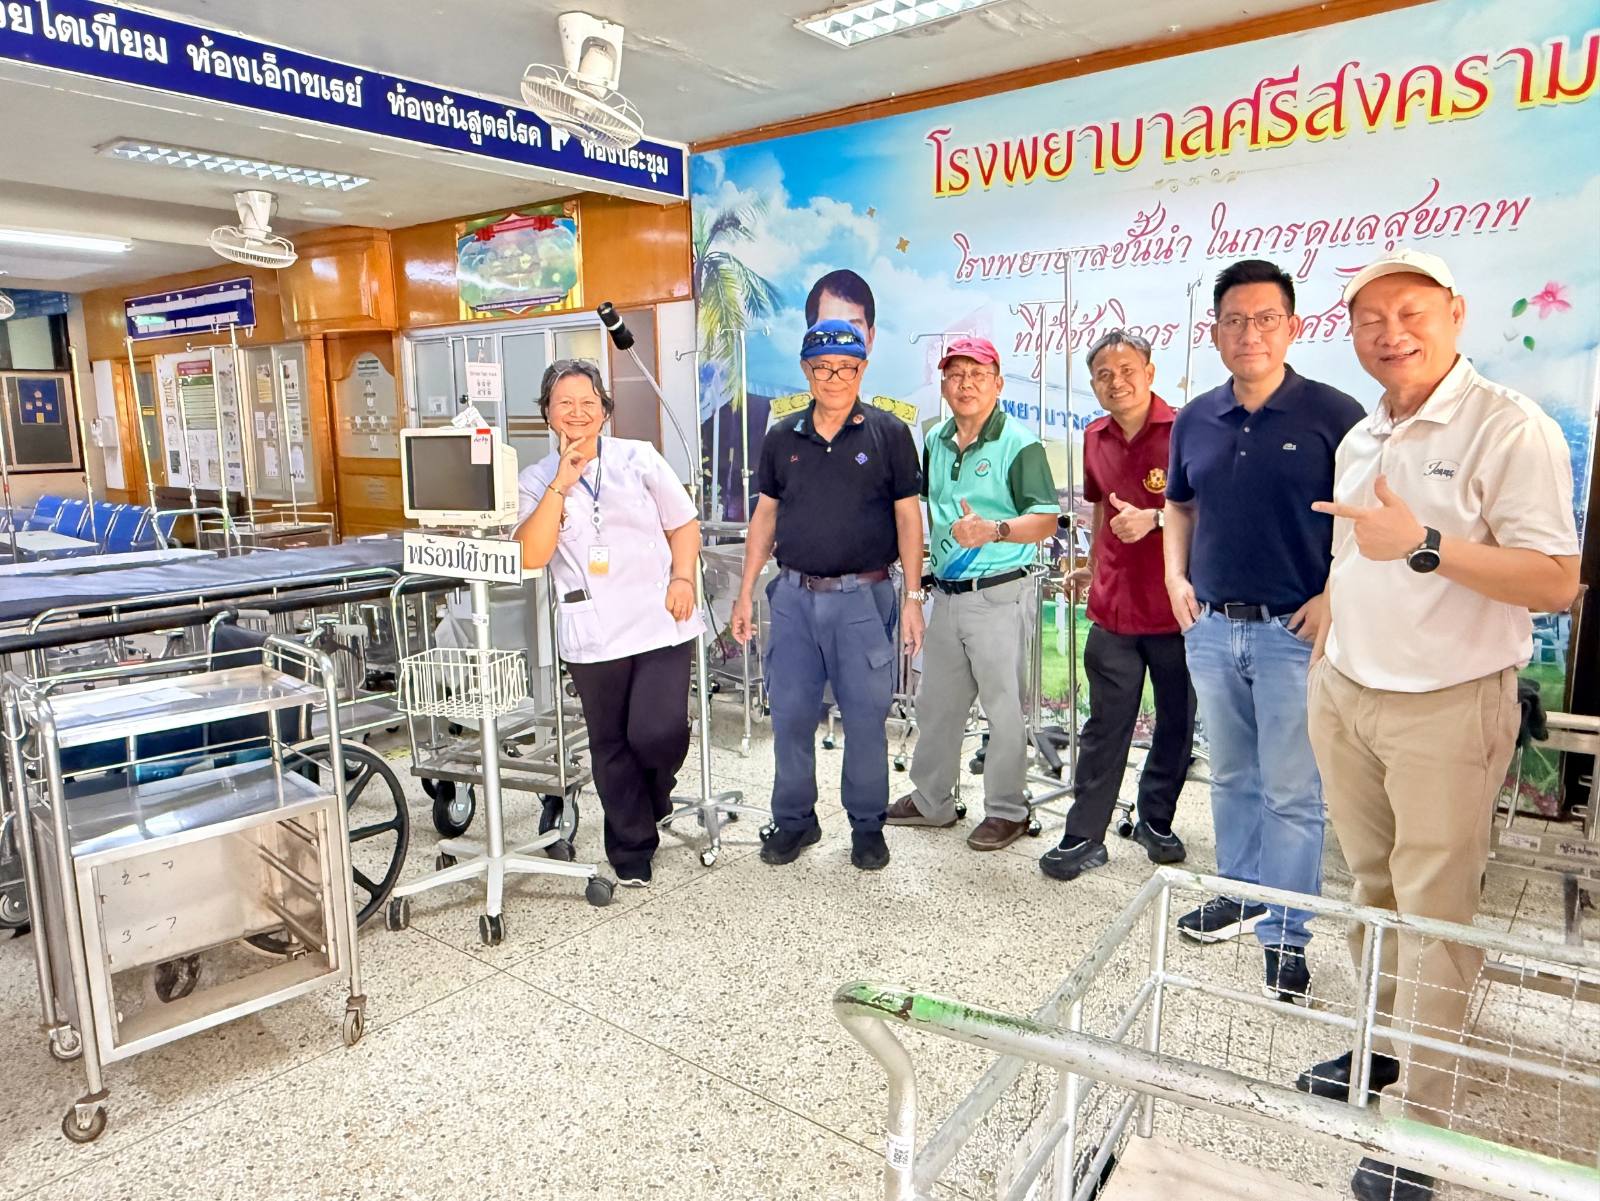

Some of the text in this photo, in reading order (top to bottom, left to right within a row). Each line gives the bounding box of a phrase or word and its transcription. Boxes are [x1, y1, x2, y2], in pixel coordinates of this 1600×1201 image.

[387, 83, 542, 146] ห้องชันสูตรโรค
[926, 35, 1600, 195] โรงพยาบาลศรีสงคราม
[1206, 178, 1532, 278] ในการดูแลสุขภาพ
[407, 538, 516, 575] พร้อมใช้งาน
